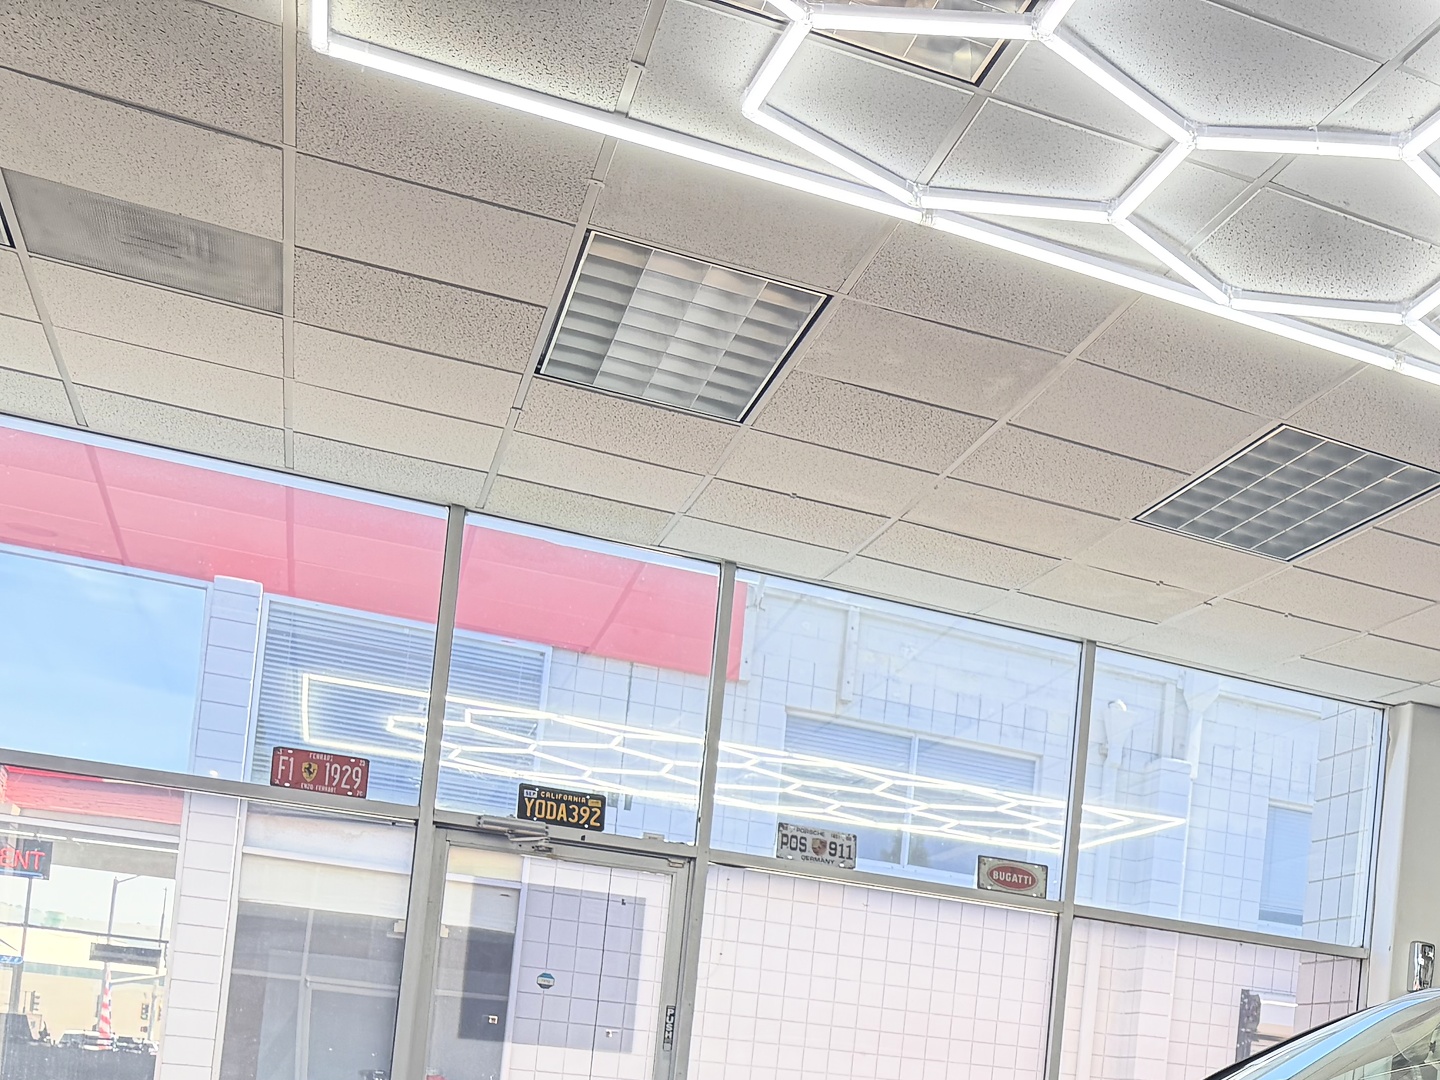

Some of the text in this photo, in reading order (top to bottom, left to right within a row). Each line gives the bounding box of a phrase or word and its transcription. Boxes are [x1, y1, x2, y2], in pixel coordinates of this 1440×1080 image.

[278, 755, 362, 791] F1 1929
[540, 791, 586, 804] CALIFORNIA
[524, 797, 601, 827] YODA392
[796, 826, 825, 838] PORSCHE
[780, 833, 853, 860] POS 911
[0, 847, 46, 871] ENT
[800, 854, 835, 865] GERMANY
[992, 870, 1032, 885] BUGATTI
[665, 1008, 674, 1039] PUSH
